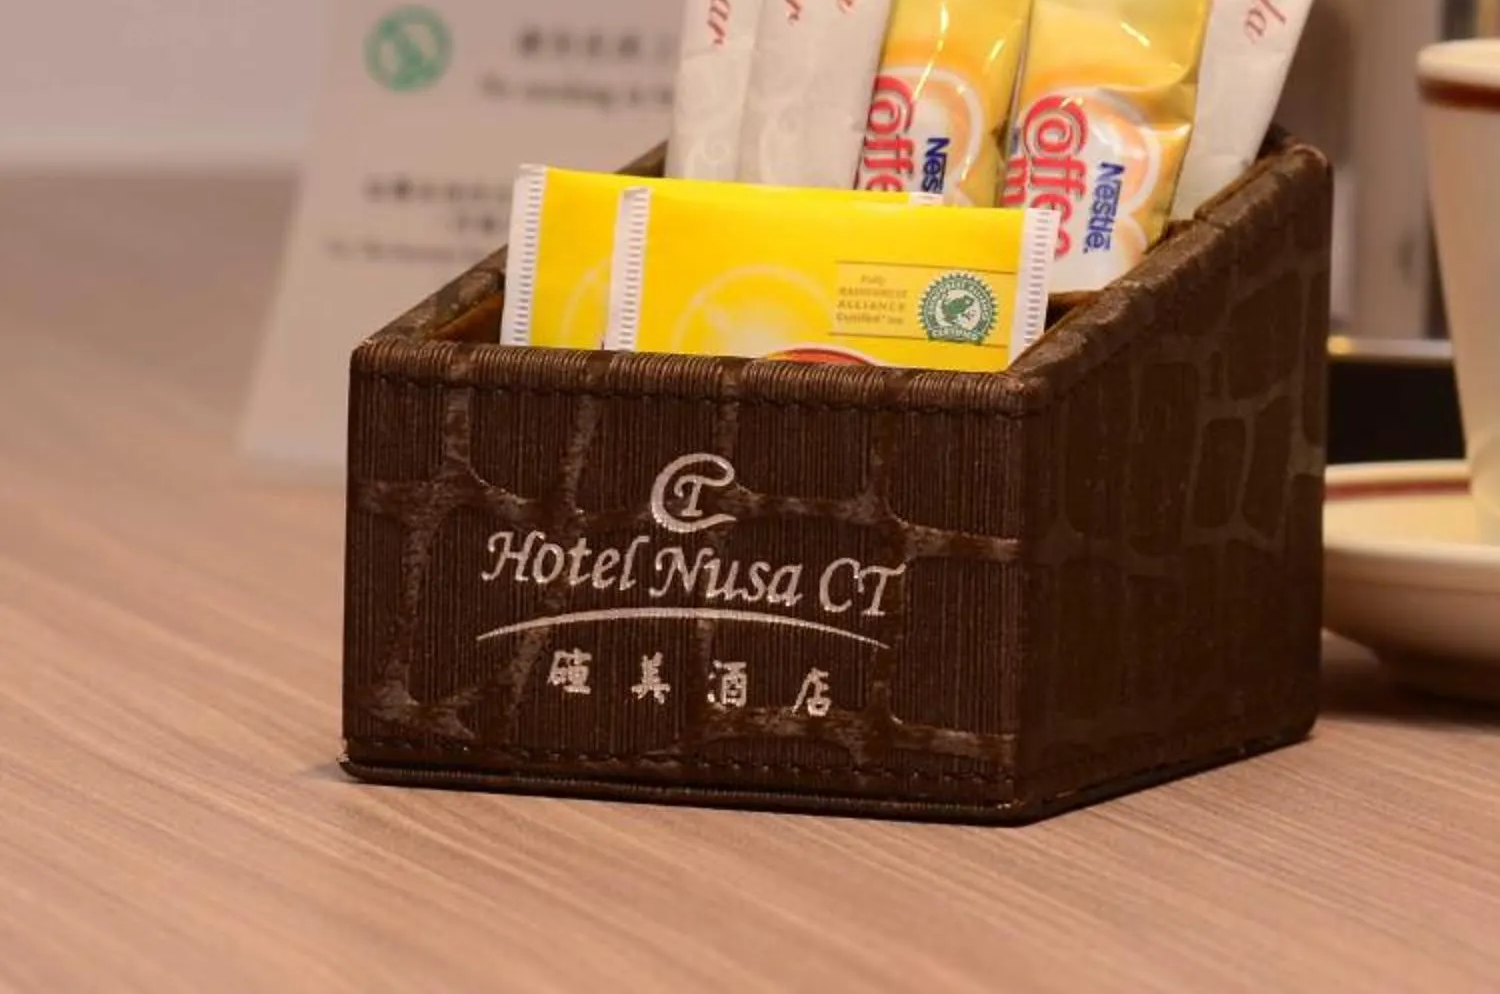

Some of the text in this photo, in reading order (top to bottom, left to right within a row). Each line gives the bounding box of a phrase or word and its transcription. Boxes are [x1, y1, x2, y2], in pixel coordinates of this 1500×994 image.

[481, 529, 907, 615] Hotel Nusa CT
